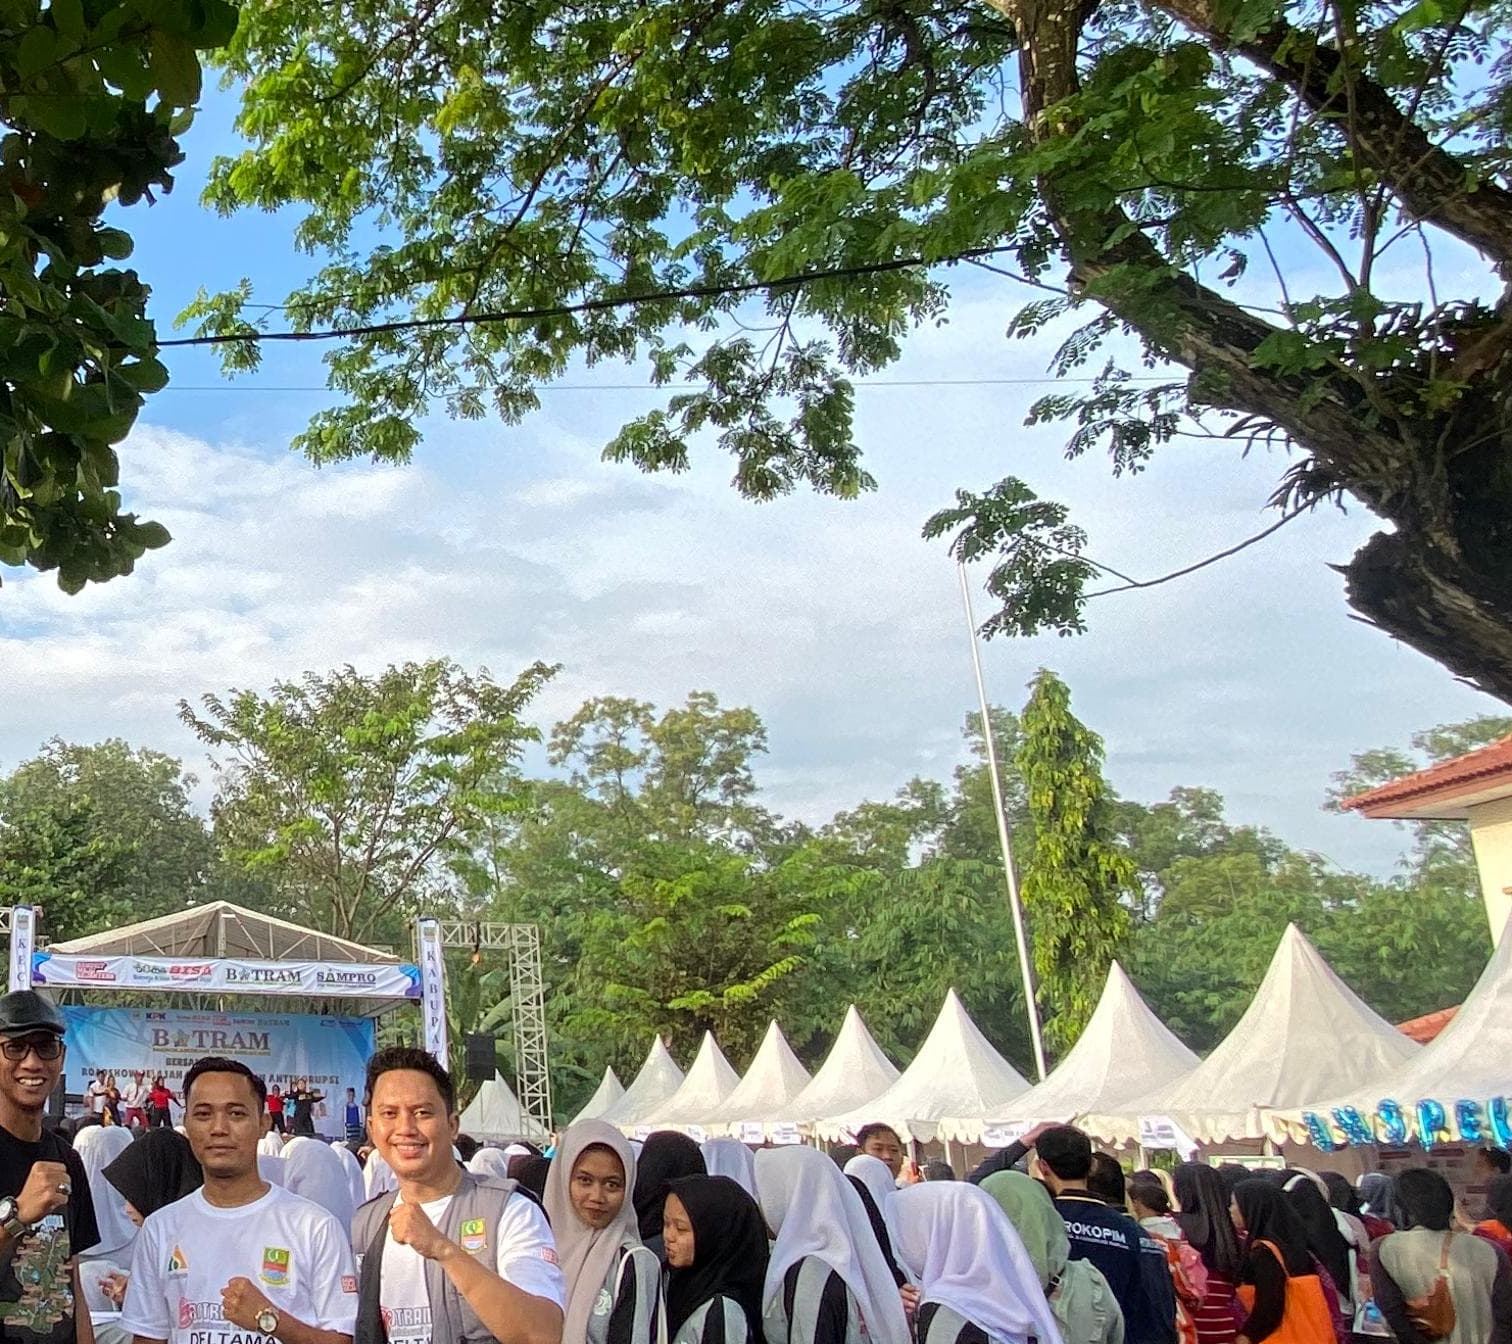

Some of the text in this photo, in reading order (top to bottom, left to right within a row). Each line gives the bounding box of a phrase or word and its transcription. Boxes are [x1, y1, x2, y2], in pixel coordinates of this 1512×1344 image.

[169, 966, 211, 976] BISA
[316, 969, 376, 982] SAMPRO
[146, 1012, 166, 1020] KPK
